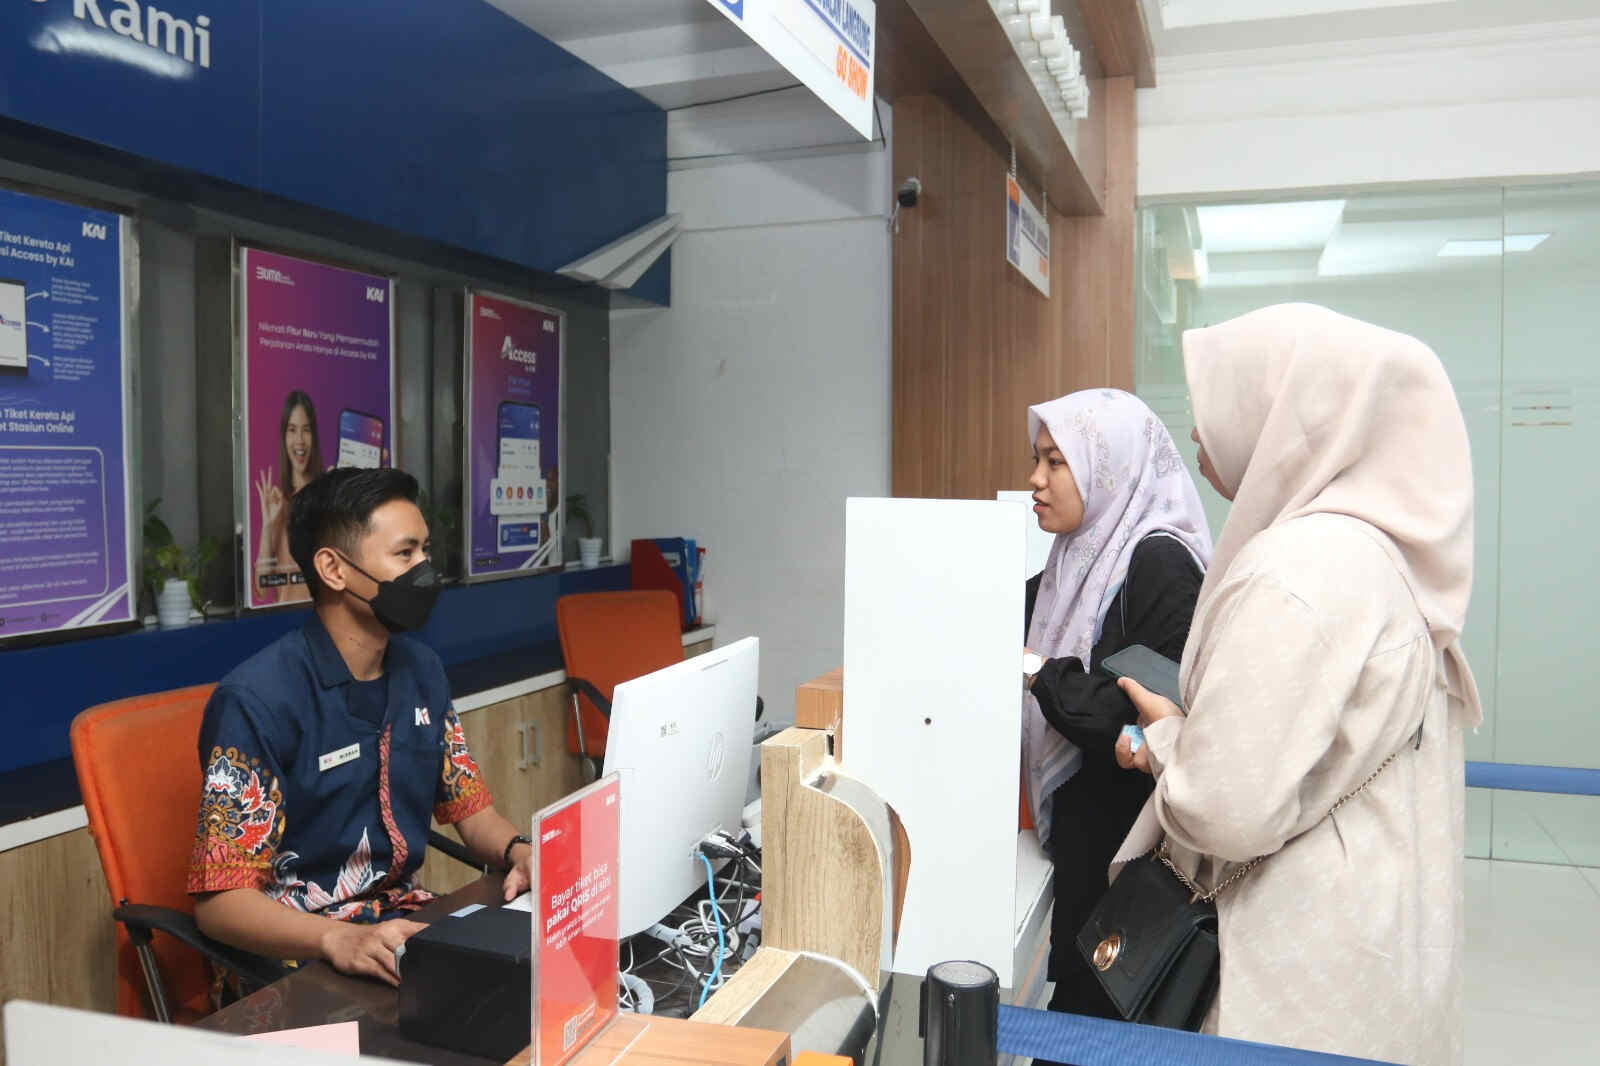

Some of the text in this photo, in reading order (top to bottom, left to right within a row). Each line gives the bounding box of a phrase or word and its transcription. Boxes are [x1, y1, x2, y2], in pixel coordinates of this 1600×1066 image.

[837, 43, 868, 101] GO SHOW
[23, 234, 54, 249] Kereta
[11, 247, 45, 262] Access
[59, 256, 75, 267] KAI
[501, 336, 536, 362] Access
[4, 408, 28, 420] Tiket
[29, 409, 60, 421] Kereta
[9, 421, 45, 433] Stasiun
[46, 422, 74, 433] Online
[551, 886, 574, 910] Bayar
[546, 901, 569, 932] pakai
[570, 889, 590, 912] QRIS
